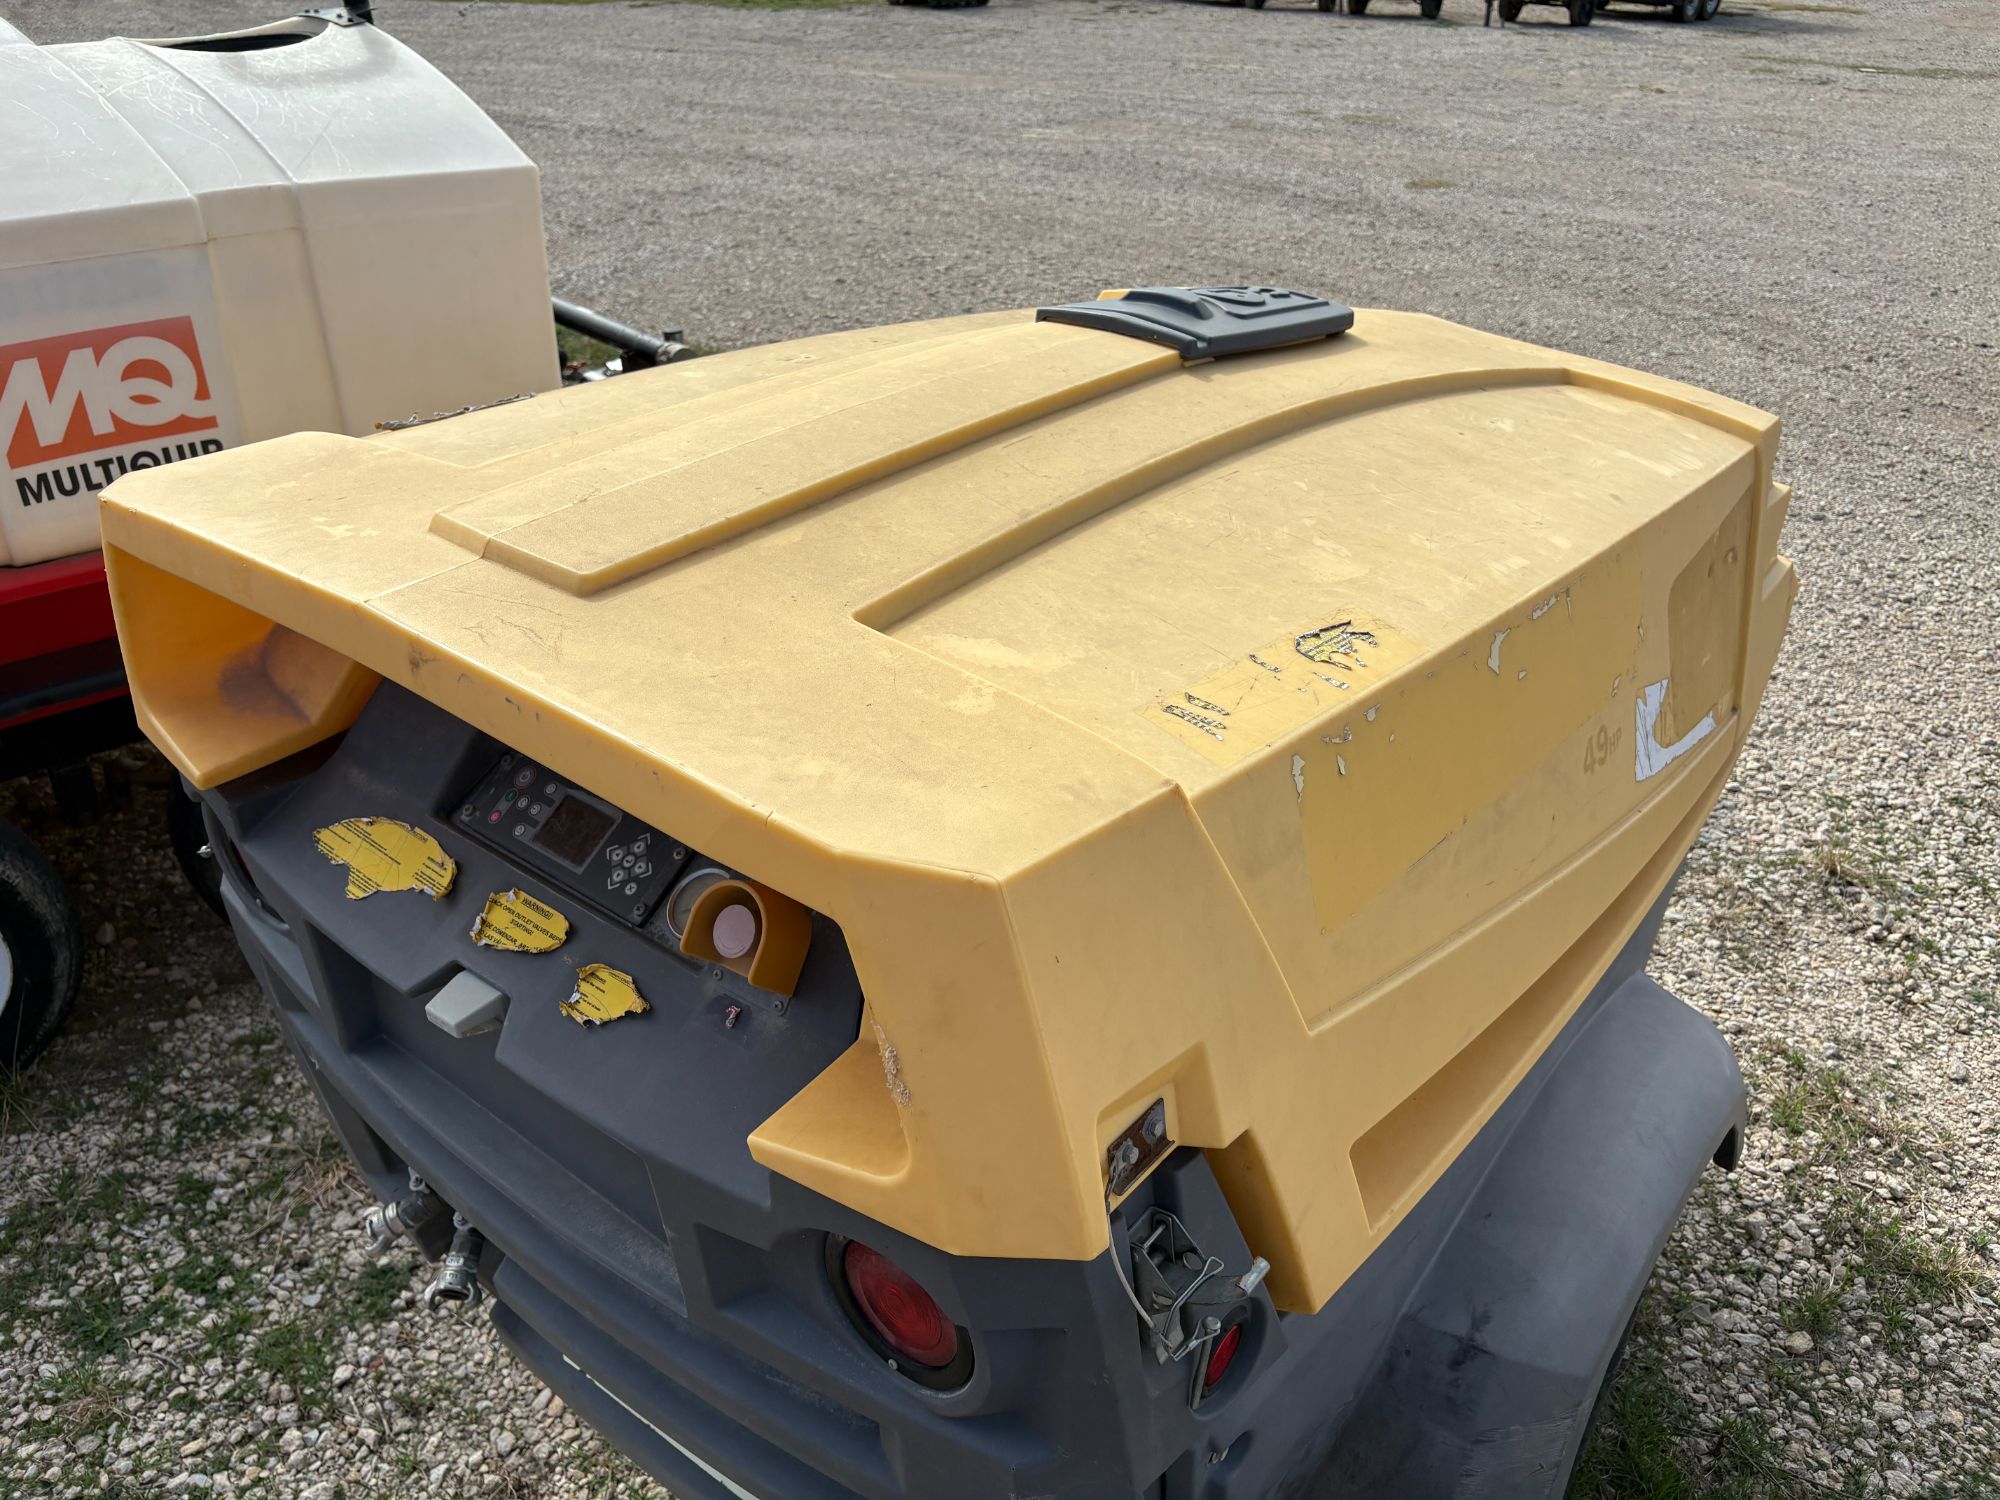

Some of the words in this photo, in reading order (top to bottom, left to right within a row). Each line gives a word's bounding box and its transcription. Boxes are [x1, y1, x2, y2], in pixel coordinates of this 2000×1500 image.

[0, 336, 217, 448] MQ
[515, 912, 533, 926] OUTLET
[532, 922, 550, 937] VALVES
